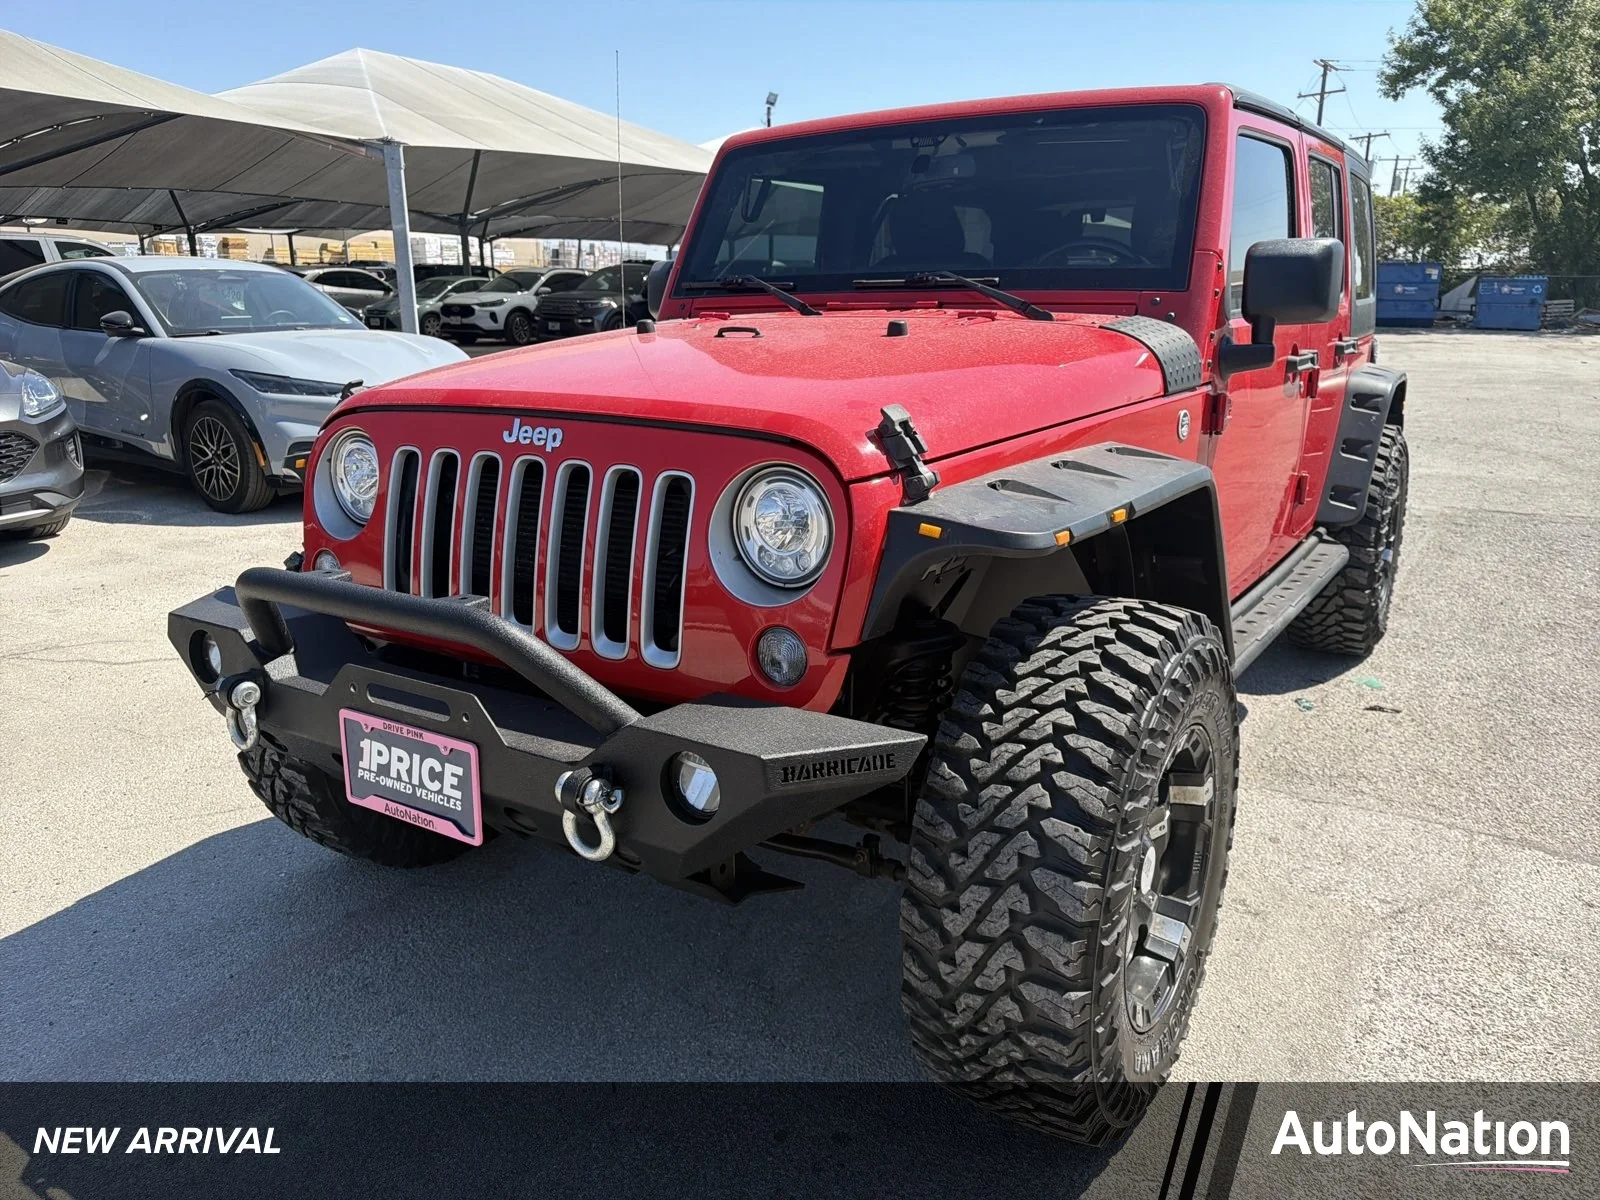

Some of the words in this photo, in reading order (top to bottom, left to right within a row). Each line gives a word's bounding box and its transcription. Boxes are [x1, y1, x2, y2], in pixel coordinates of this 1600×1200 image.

[503, 418, 563, 453] Jeep
[382, 722, 405, 735] DRIVE
[406, 728, 424, 741] PINK
[358, 738, 463, 800] 1PRICE
[779, 753, 896, 782] BARRICADE
[357, 769, 413, 795] PRE-OWNED
[415, 788, 462, 811] VEHICLES
[384, 803, 435, 829] AutoNation
